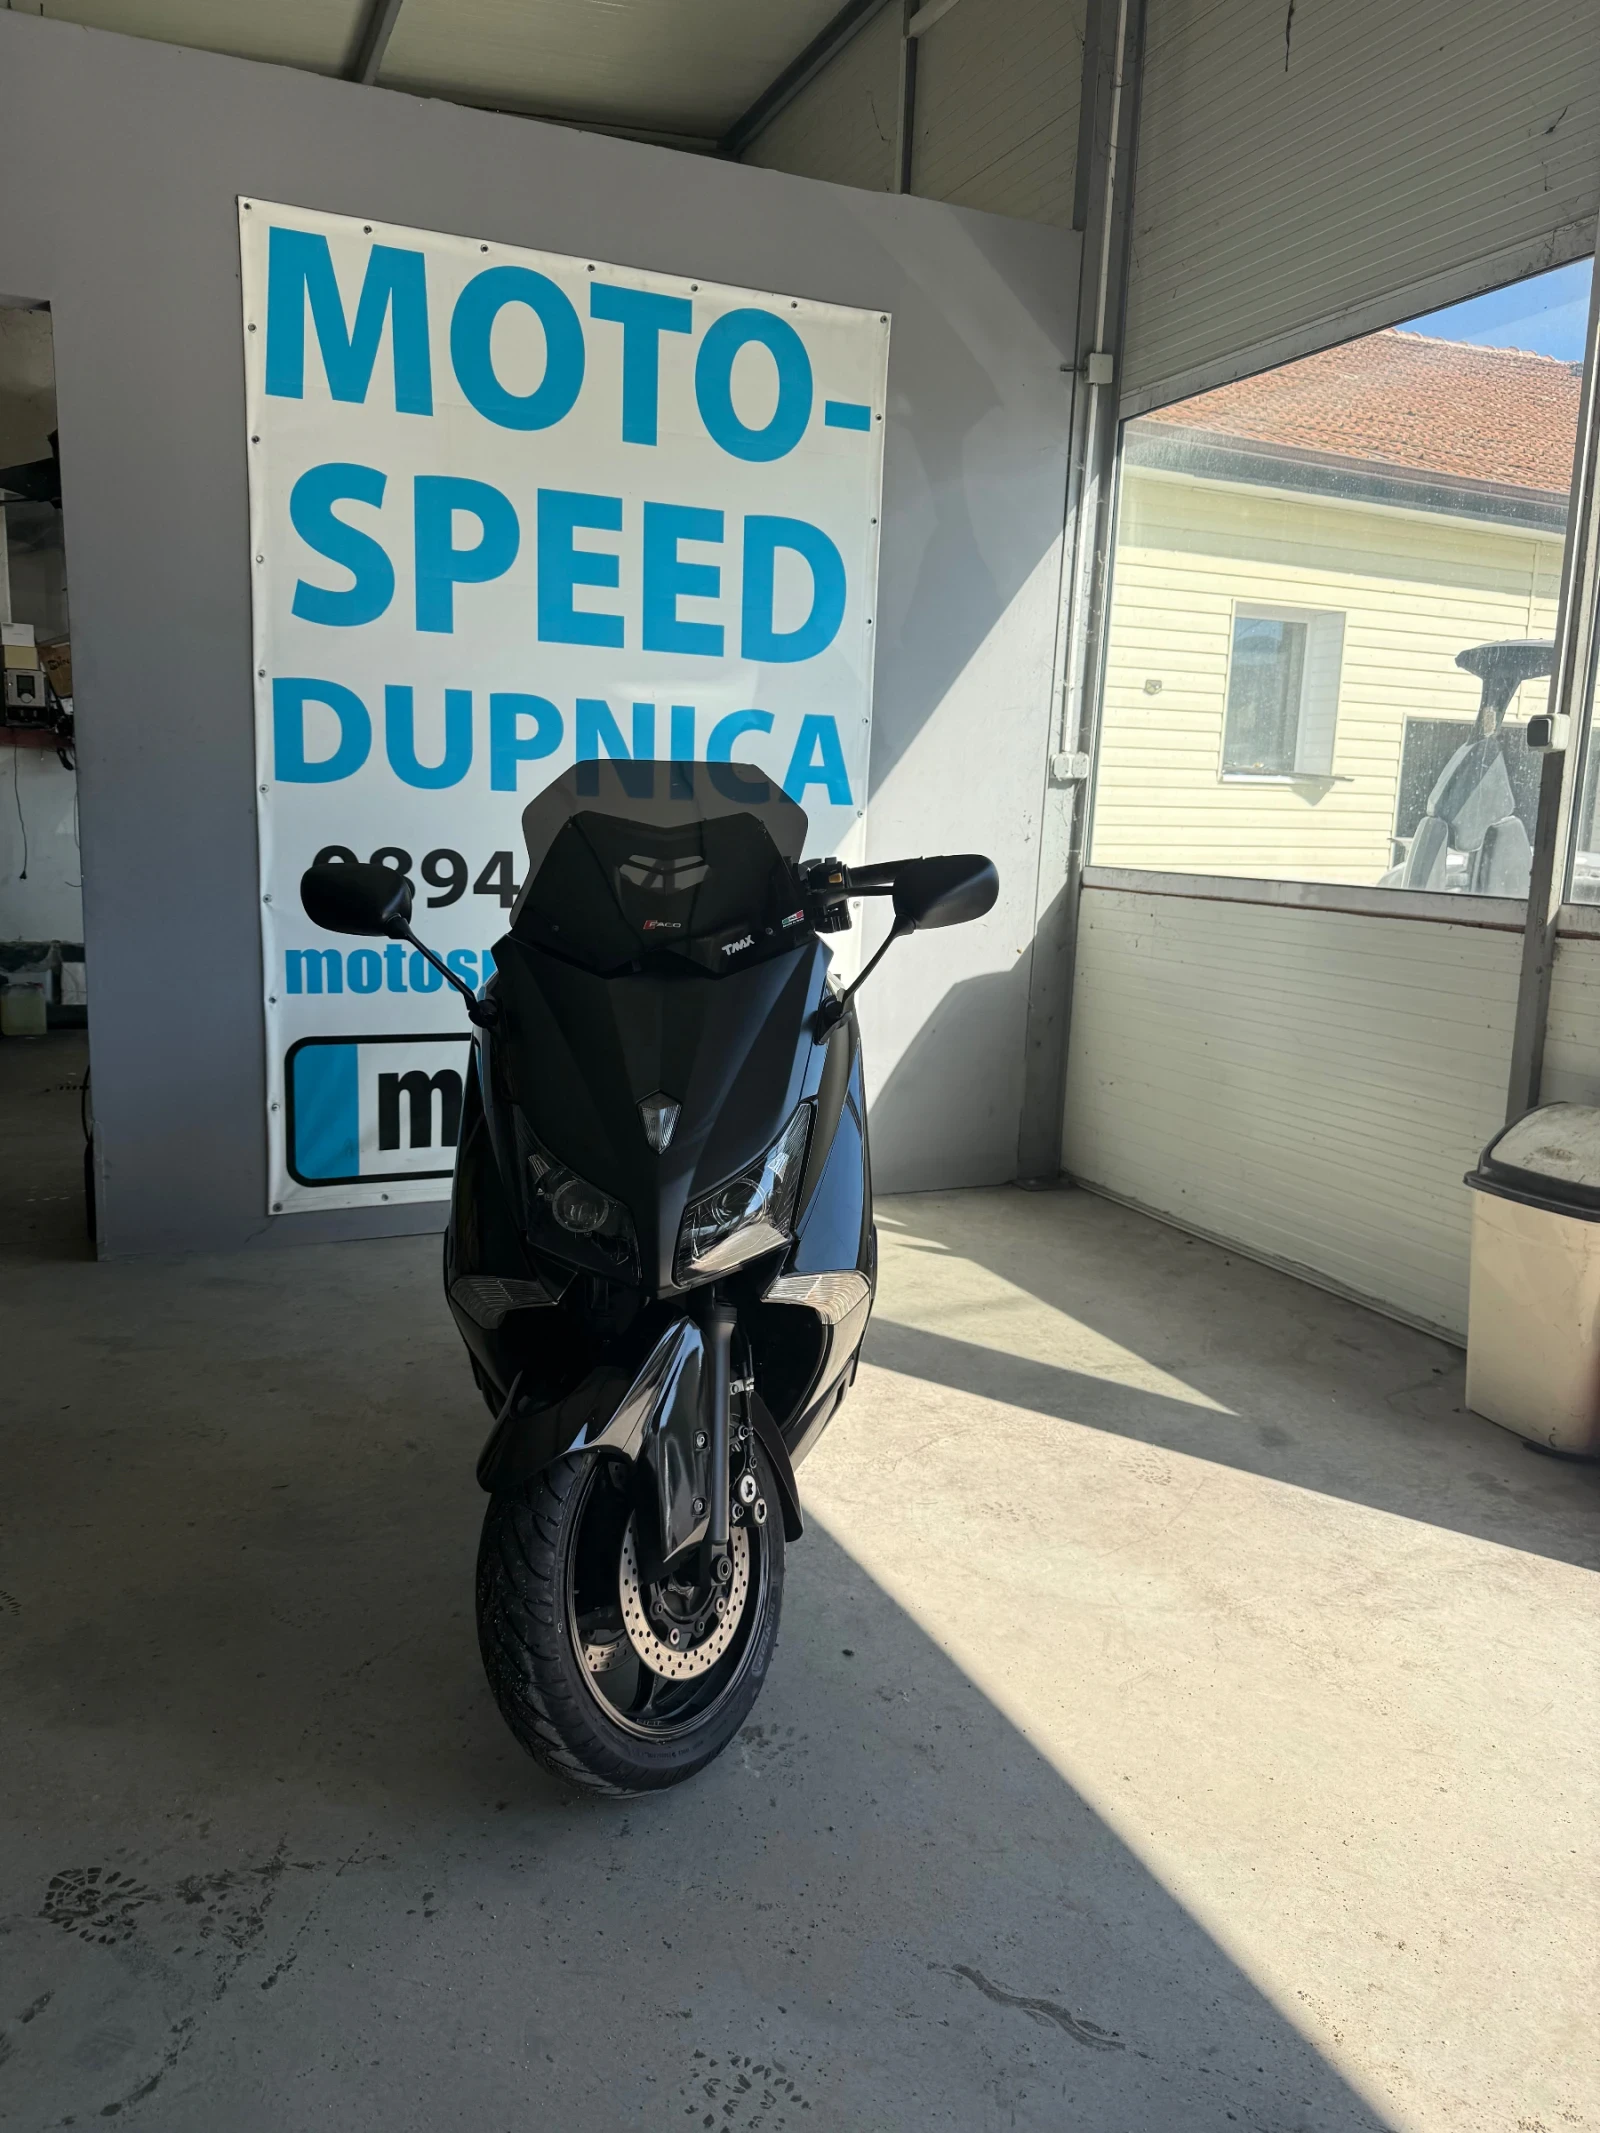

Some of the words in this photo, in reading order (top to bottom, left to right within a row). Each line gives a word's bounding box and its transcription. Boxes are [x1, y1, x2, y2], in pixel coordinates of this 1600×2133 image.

[265, 226, 872, 462] MOTO-
[289, 462, 847, 663] SPEED
[272, 676, 853, 805] DUPNICA
